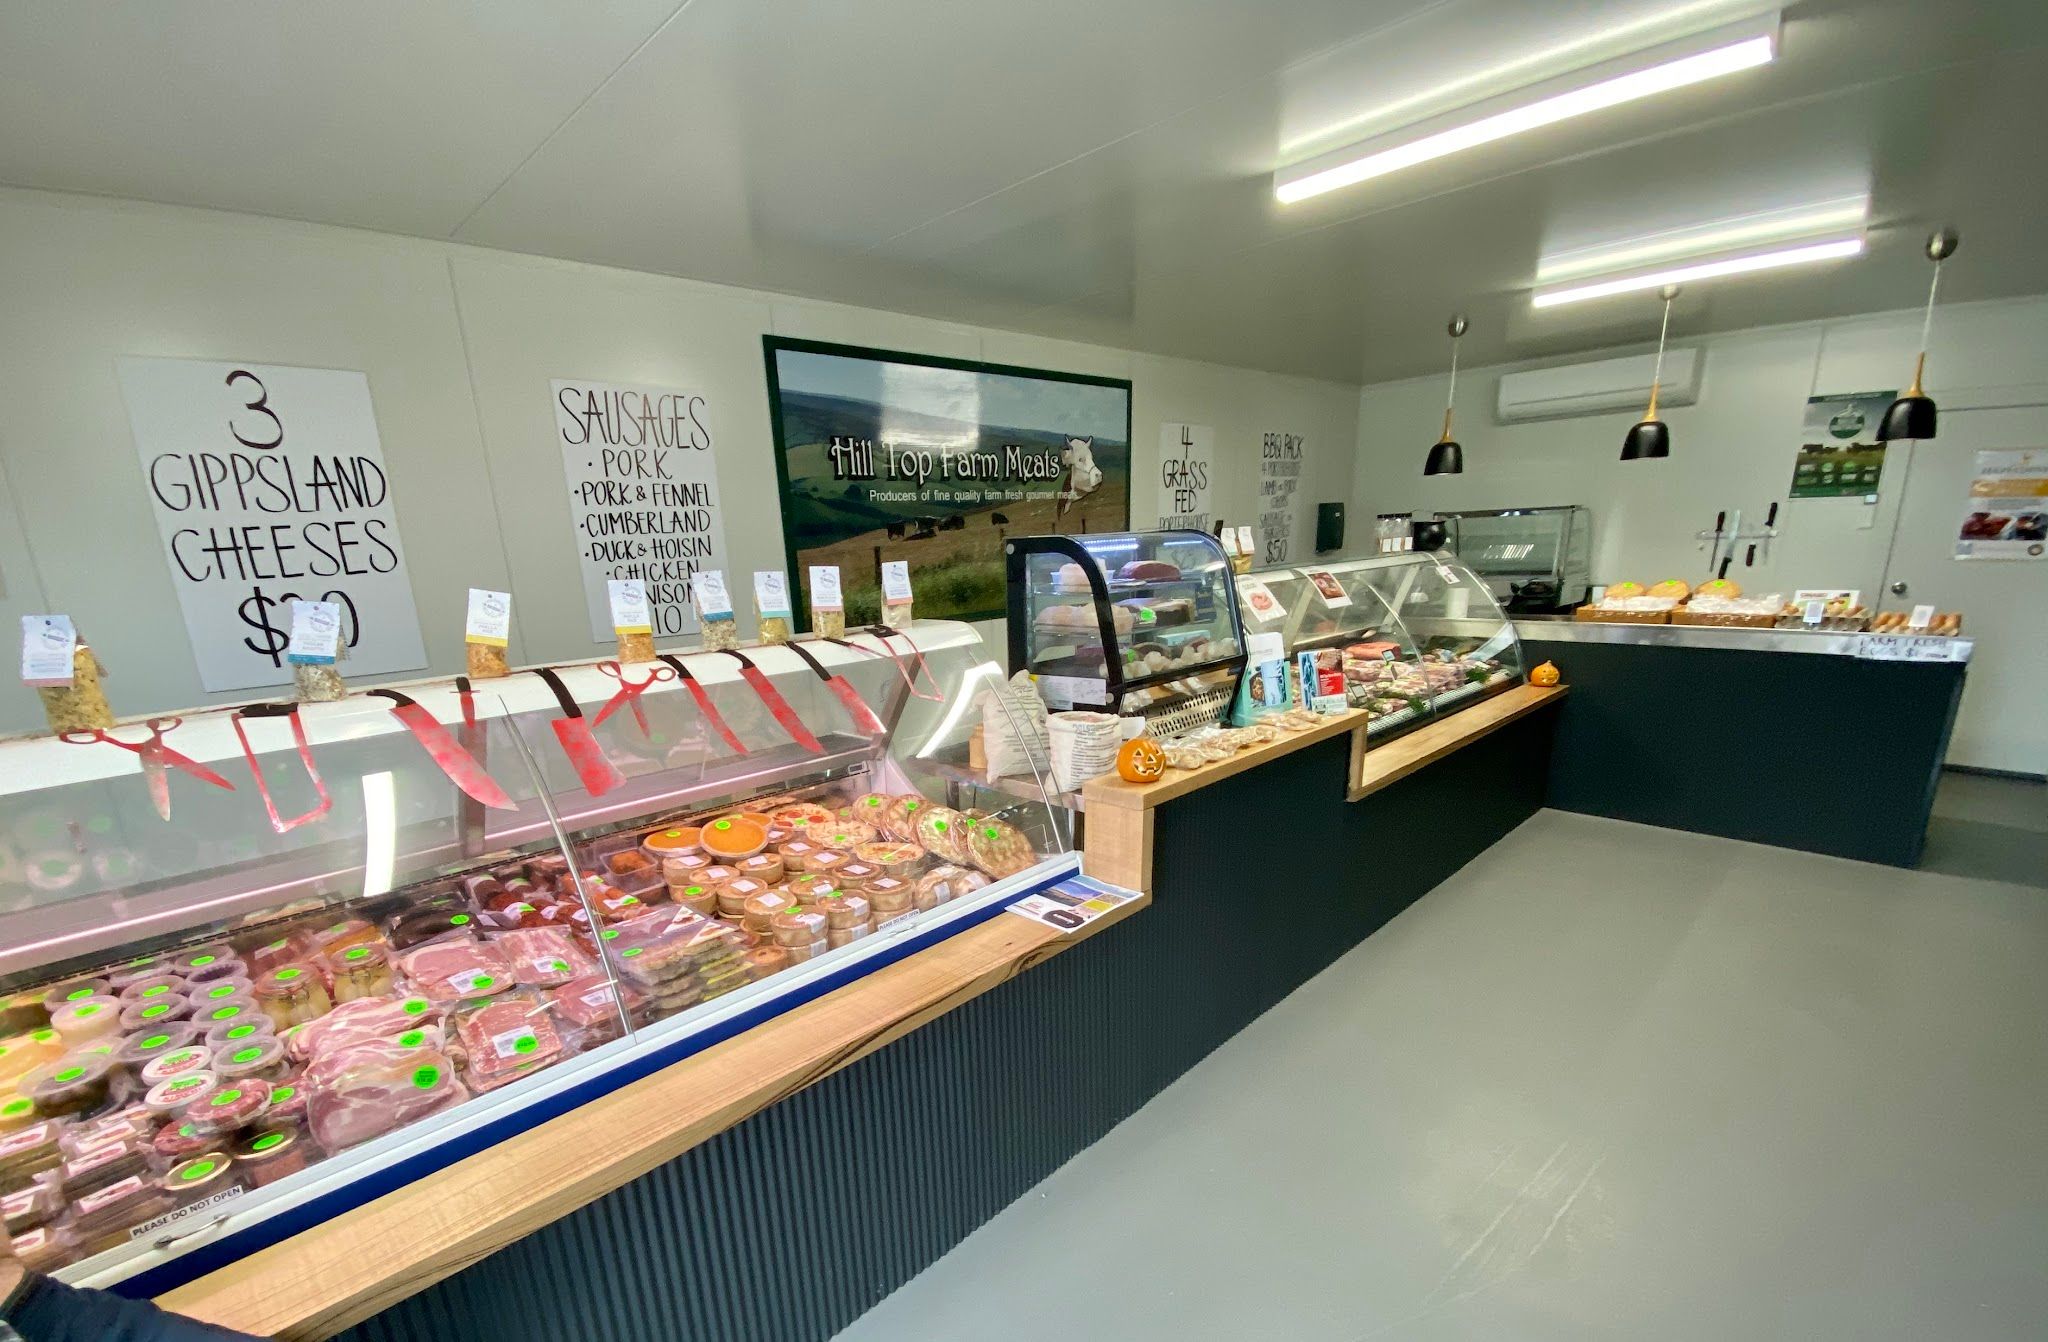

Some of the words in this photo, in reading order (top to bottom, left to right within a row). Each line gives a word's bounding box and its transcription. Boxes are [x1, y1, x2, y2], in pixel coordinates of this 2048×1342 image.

[226, 370, 283, 449] 3
[559, 387, 710, 450] SAUSAGES
[1181, 425, 1194, 459] 4
[1263, 433, 1281, 459] BBQ
[1284, 434, 1304, 459] PACK
[602, 449, 672, 480] PORK
[831, 437, 875, 477] Hill
[882, 440, 932, 485] Top
[940, 443, 998, 477] Farm
[1005, 446, 1060, 480] Meats
[1163, 459, 1207, 489] GRASS
[150, 453, 386, 512] GIPPSLAND
[581, 481, 632, 507] PORK
[636, 485, 647, 501] &
[653, 483, 715, 507] FENNEL
[869, 490, 917, 502] Producers
[921, 490, 931, 501] of
[933, 490, 950, 501] fine
[954, 490, 981, 503] quality
[984, 489, 1001, 500] farm
[1004, 489, 1023, 500] fresh
[1026, 491, 1055, 502] gourmet
[1175, 490, 1197, 513] FED
[586, 509, 711, 537] CUMBERLAND
[172, 519, 398, 582] CHEESES
[592, 541, 637, 562] DUCK
[637, 542, 648, 557] &
[650, 535, 712, 560] HOISIN
[1265, 540, 1287, 563] $50
[614, 559, 699, 582] CHICKEN
[238, 586, 359, 668] $0
[133, 1215, 168, 1236] PLEASE
[171, 1209, 187, 1220] DO
[190, 1200, 211, 1213] NOT
[213, 1187, 241, 1203] OPEN
